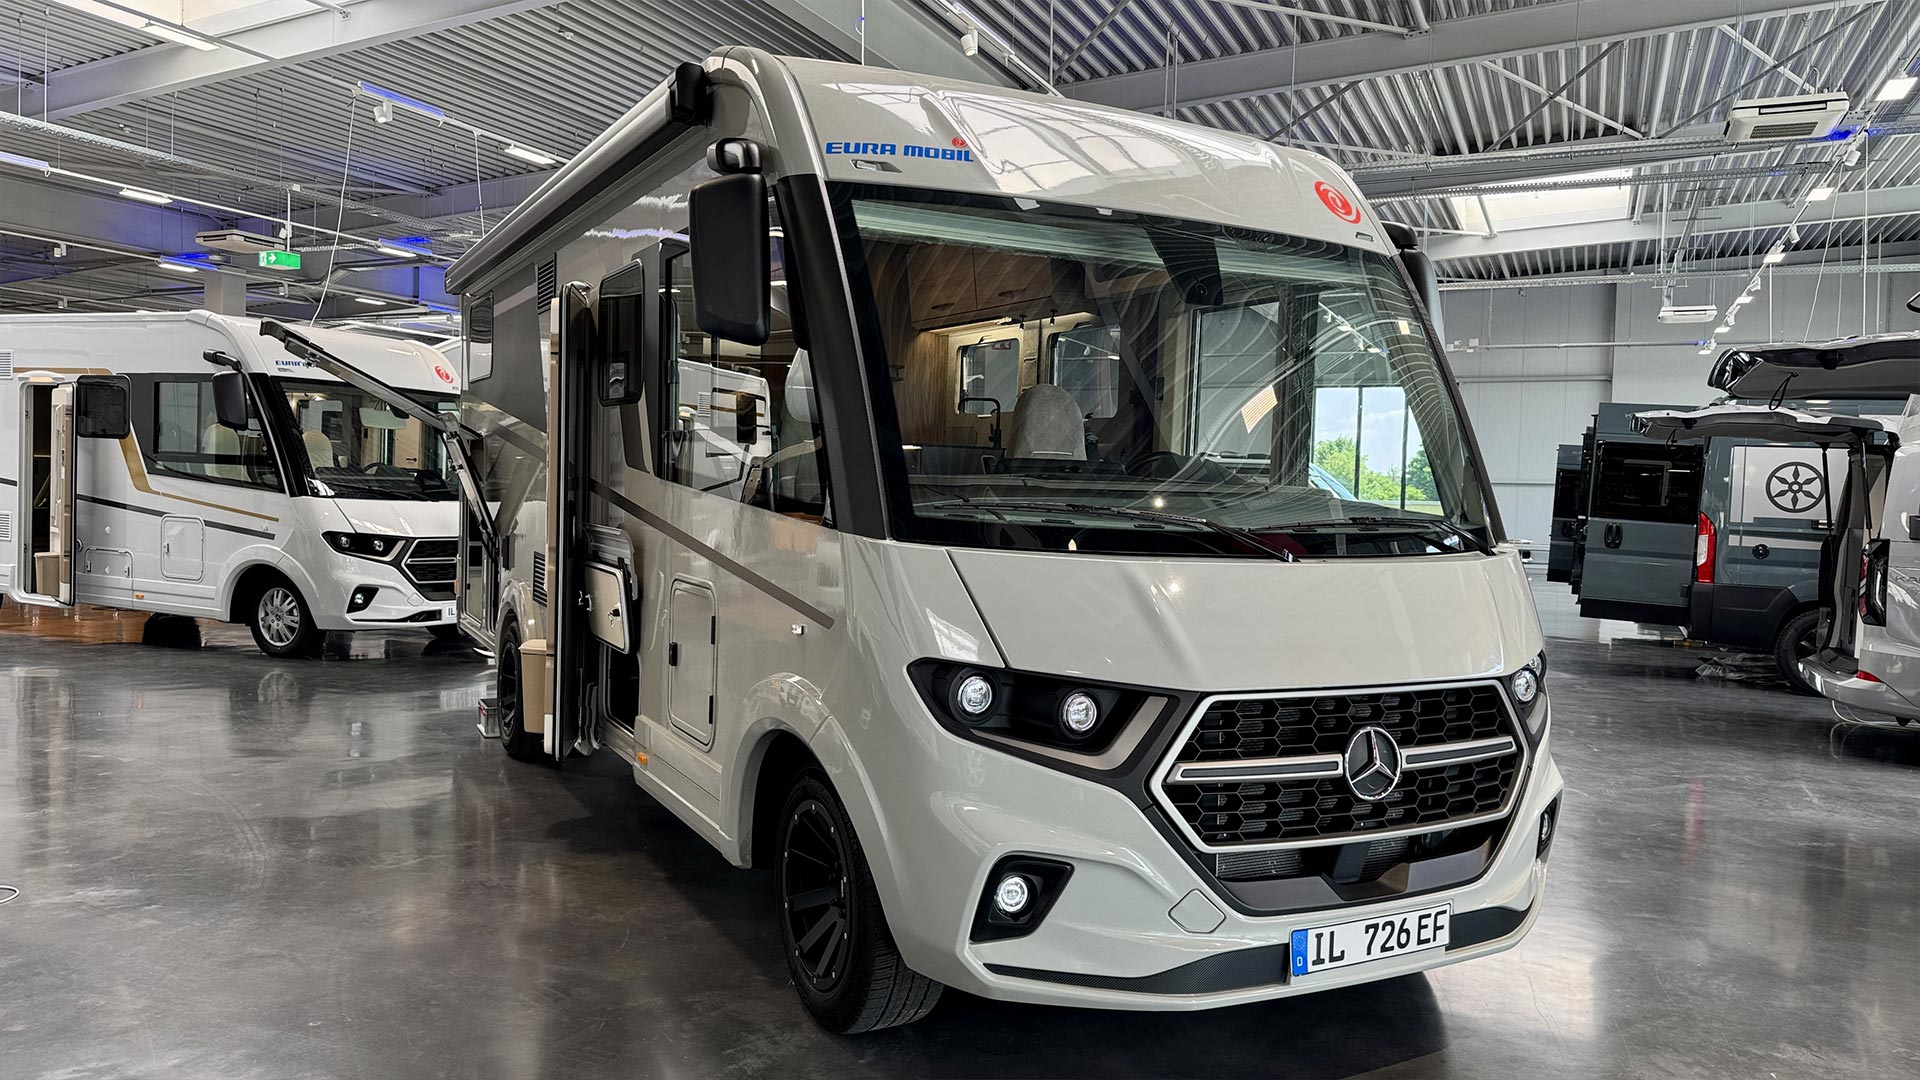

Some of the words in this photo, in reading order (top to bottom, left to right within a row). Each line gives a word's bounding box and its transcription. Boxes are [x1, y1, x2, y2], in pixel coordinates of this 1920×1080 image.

[826, 142, 896, 155] EURA
[903, 145, 974, 162] MOBIL
[1312, 931, 1345, 966] IL
[1364, 917, 1411, 956] 726
[1417, 909, 1447, 946] EF
[1297, 956, 1303, 967] D
